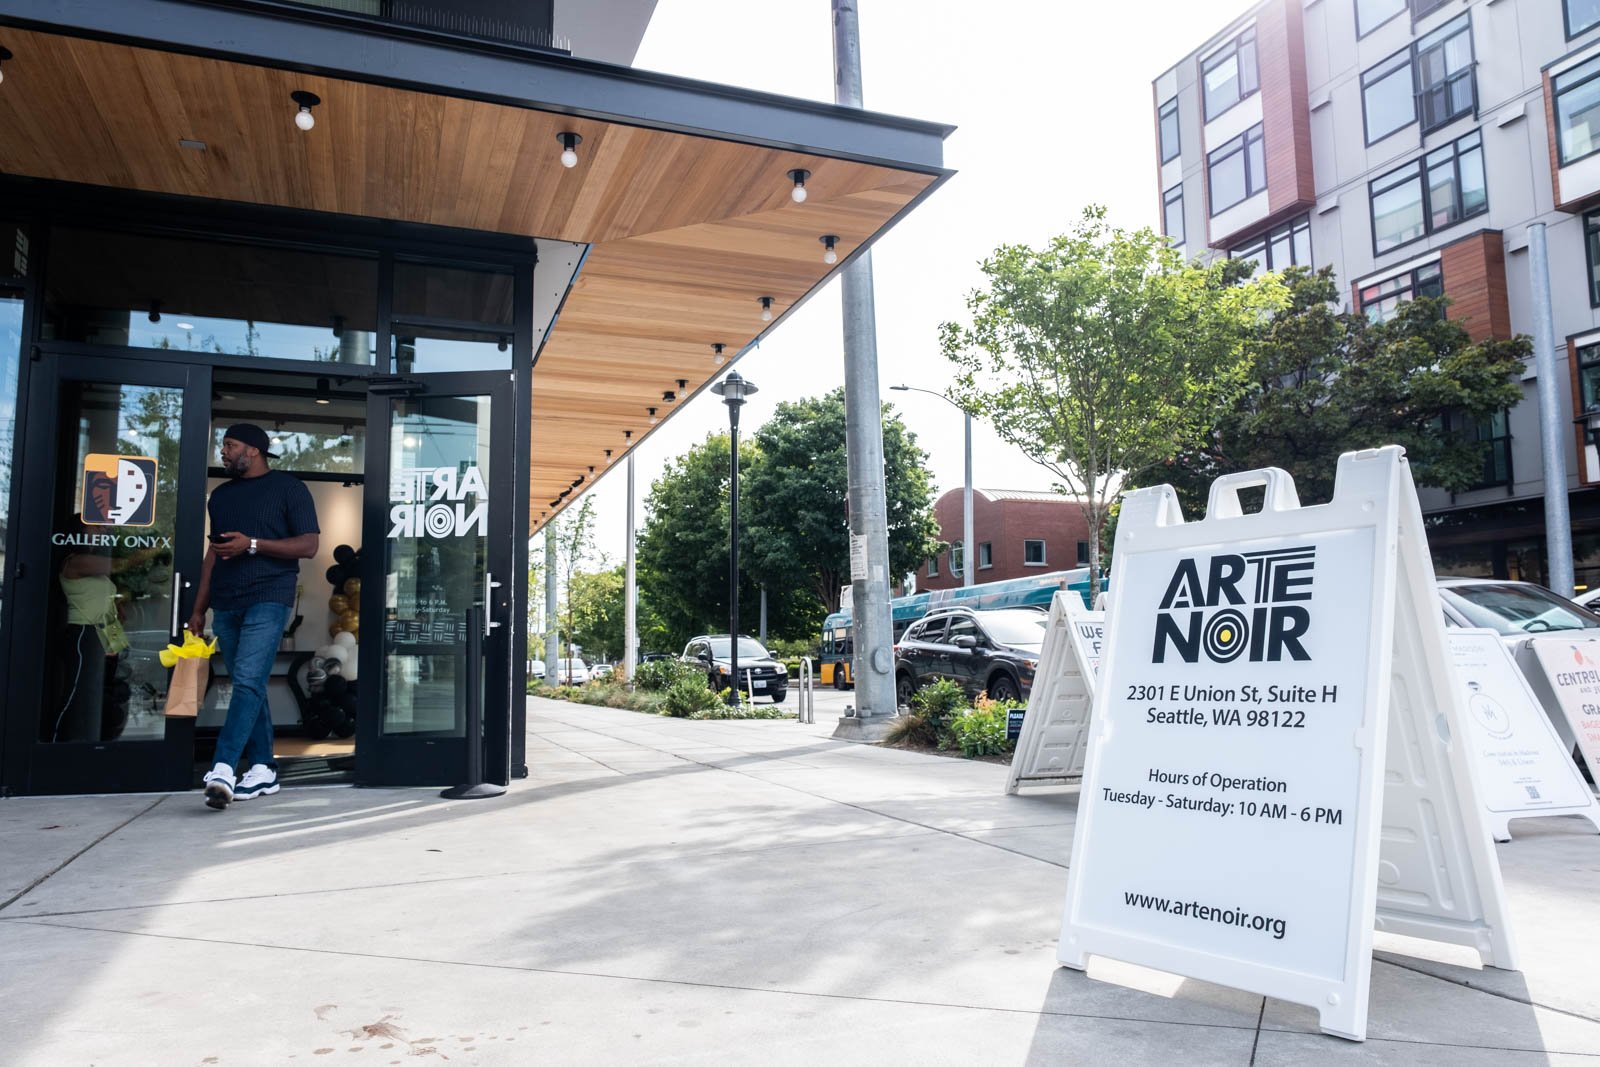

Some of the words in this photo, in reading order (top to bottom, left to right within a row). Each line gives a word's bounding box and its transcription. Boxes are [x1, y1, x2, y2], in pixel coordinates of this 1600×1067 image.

[52, 533, 120, 547] GALLERY
[124, 535, 171, 548] ONYX
[1158, 545, 1316, 610] ARTE
[1152, 606, 1312, 664] NOIR
[1127, 685, 1164, 700] 2301
[1170, 685, 1180, 701] E
[1184, 685, 1235, 702] Union
[1240, 685, 1262, 705] St,
[1267, 685, 1317, 703] Suite
[1322, 685, 1338, 703] H
[1146, 707, 1208, 727] Seattle,
[1212, 709, 1242, 726] WA
[1246, 710, 1306, 729] 98122
[1148, 769, 1189, 785] Hours
[1192, 772, 1208, 786] of
[1210, 773, 1287, 793] Operation
[1102, 787, 1156, 809] Tuesday
[1165, 793, 1234, 817] Saturday:
[1239, 802, 1257, 816] 10
[1260, 803, 1287, 820] AM
[1300, 806, 1311, 822] 6
[1315, 807, 1343, 825] PM
[1124, 891, 1287, 940] www.artenoir.org
